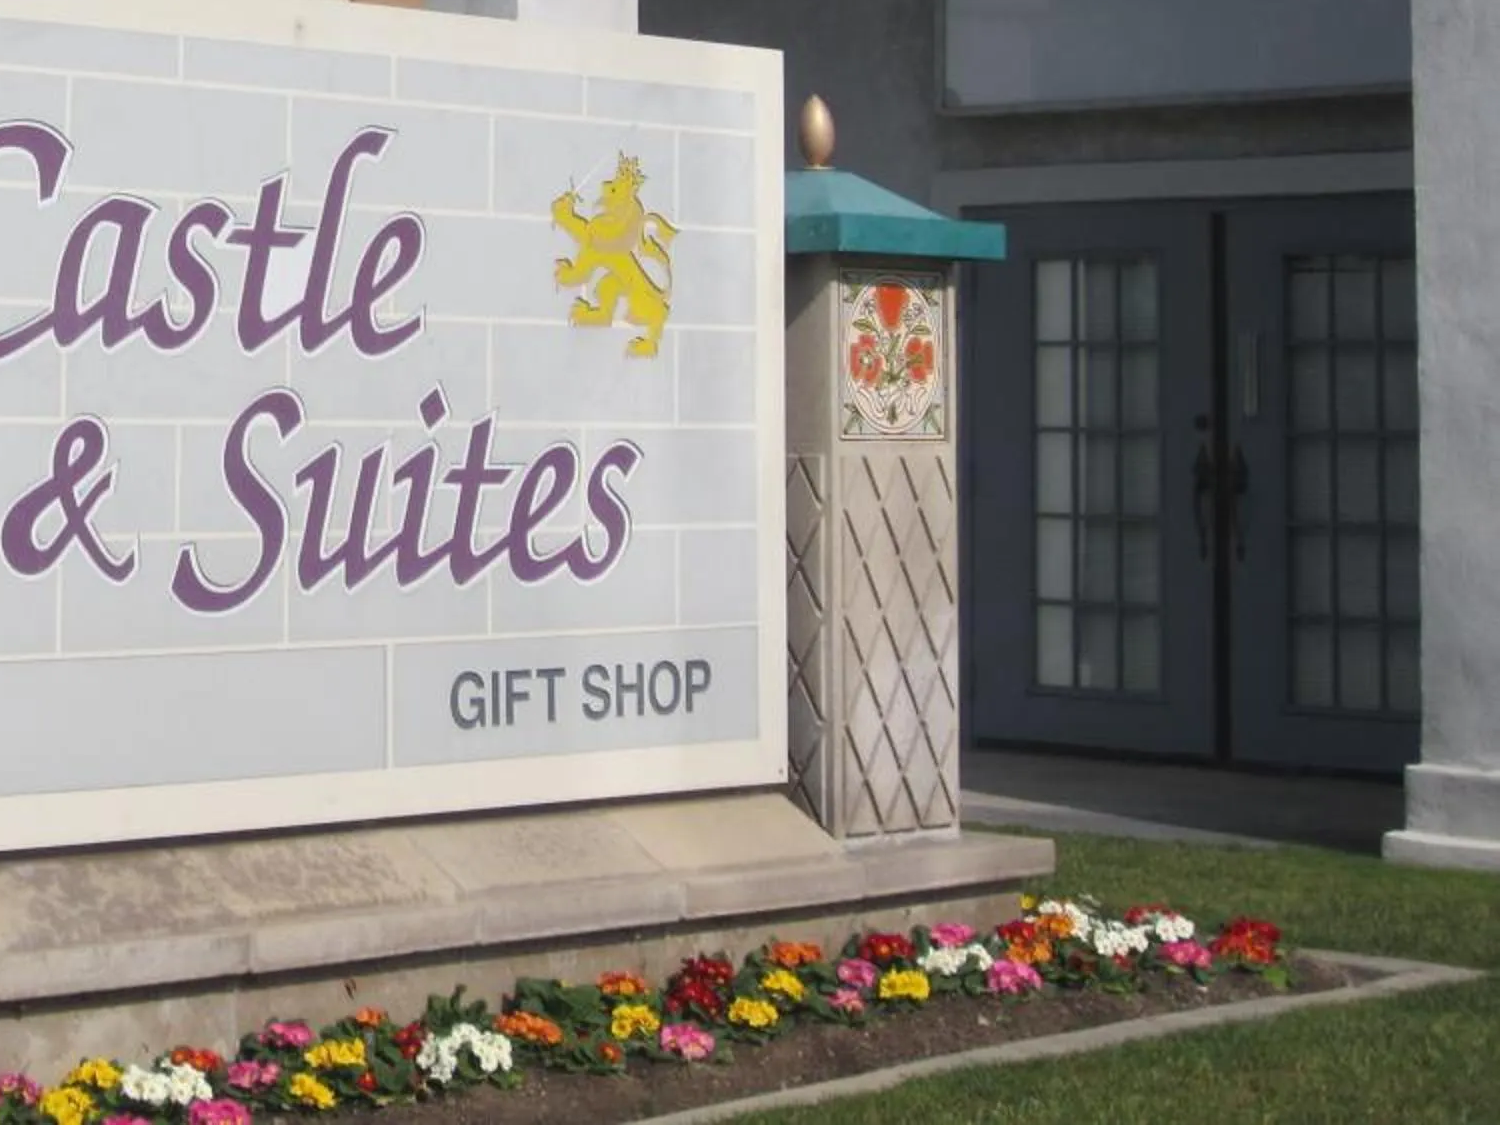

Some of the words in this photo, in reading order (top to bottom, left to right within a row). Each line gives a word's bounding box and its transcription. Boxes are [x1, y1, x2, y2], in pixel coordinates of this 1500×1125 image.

[2, 417, 136, 583] &
[173, 387, 640, 613] Suites
[450, 668, 566, 729] GIFT
[581, 659, 712, 721] SHOP
